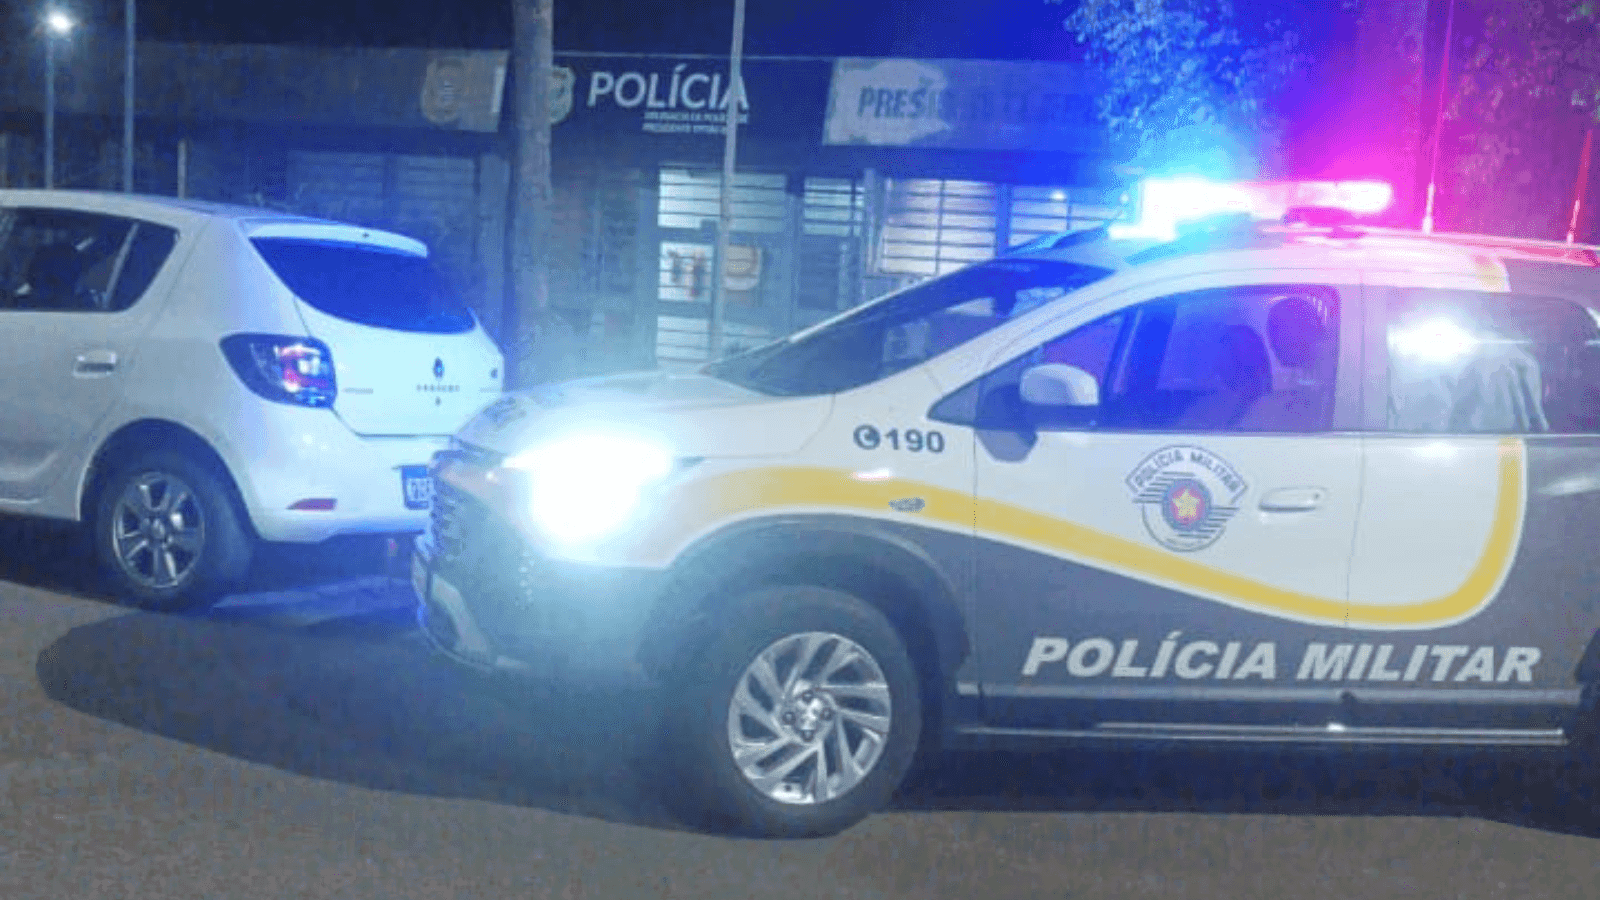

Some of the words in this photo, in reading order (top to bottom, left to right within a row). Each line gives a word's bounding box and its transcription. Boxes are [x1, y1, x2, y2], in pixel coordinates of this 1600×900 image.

[586, 63, 749, 109] POLÍCIA
[884, 428, 945, 454] 190
[1190, 451, 1241, 493] MILITAR
[1022, 631, 1277, 680] POLÍCIA
[1297, 644, 1542, 683] MILITAR
